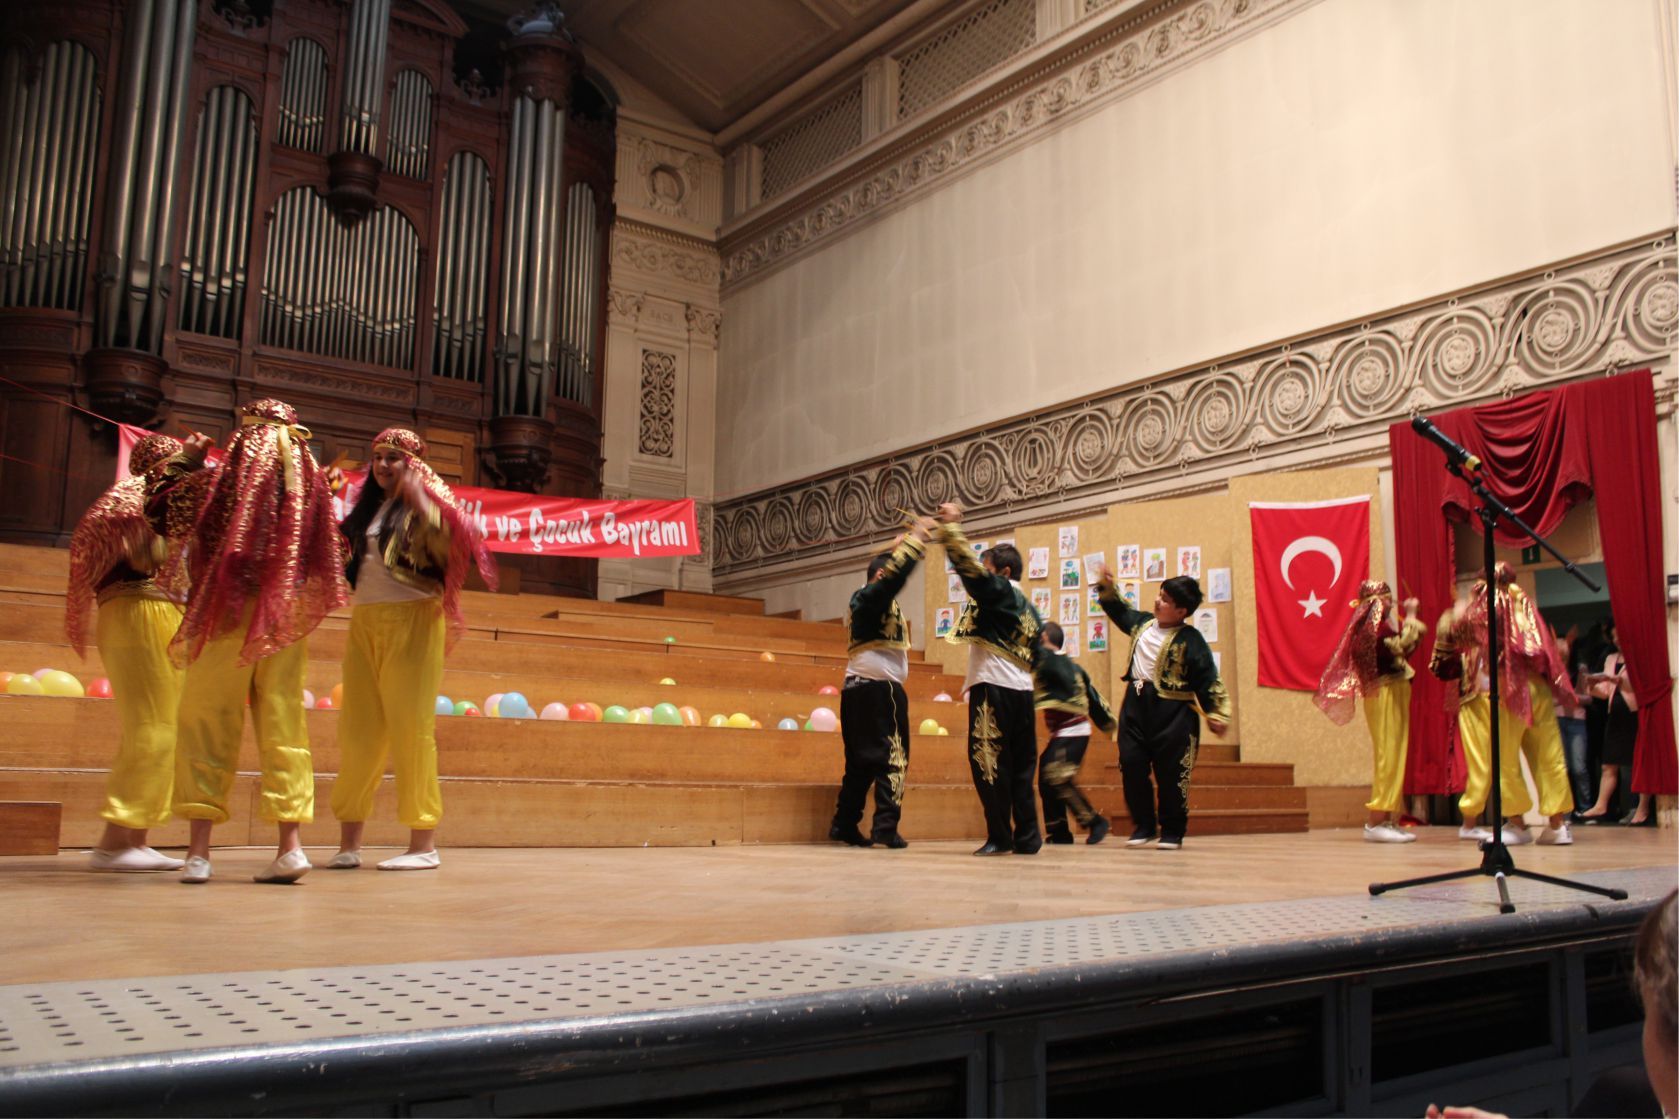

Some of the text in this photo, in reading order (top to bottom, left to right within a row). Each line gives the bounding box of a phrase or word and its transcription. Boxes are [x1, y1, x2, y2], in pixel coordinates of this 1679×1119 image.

[494, 515, 522, 542] ve
[529, 508, 595, 552] Çocuk
[601, 512, 688, 556] Bayramı
